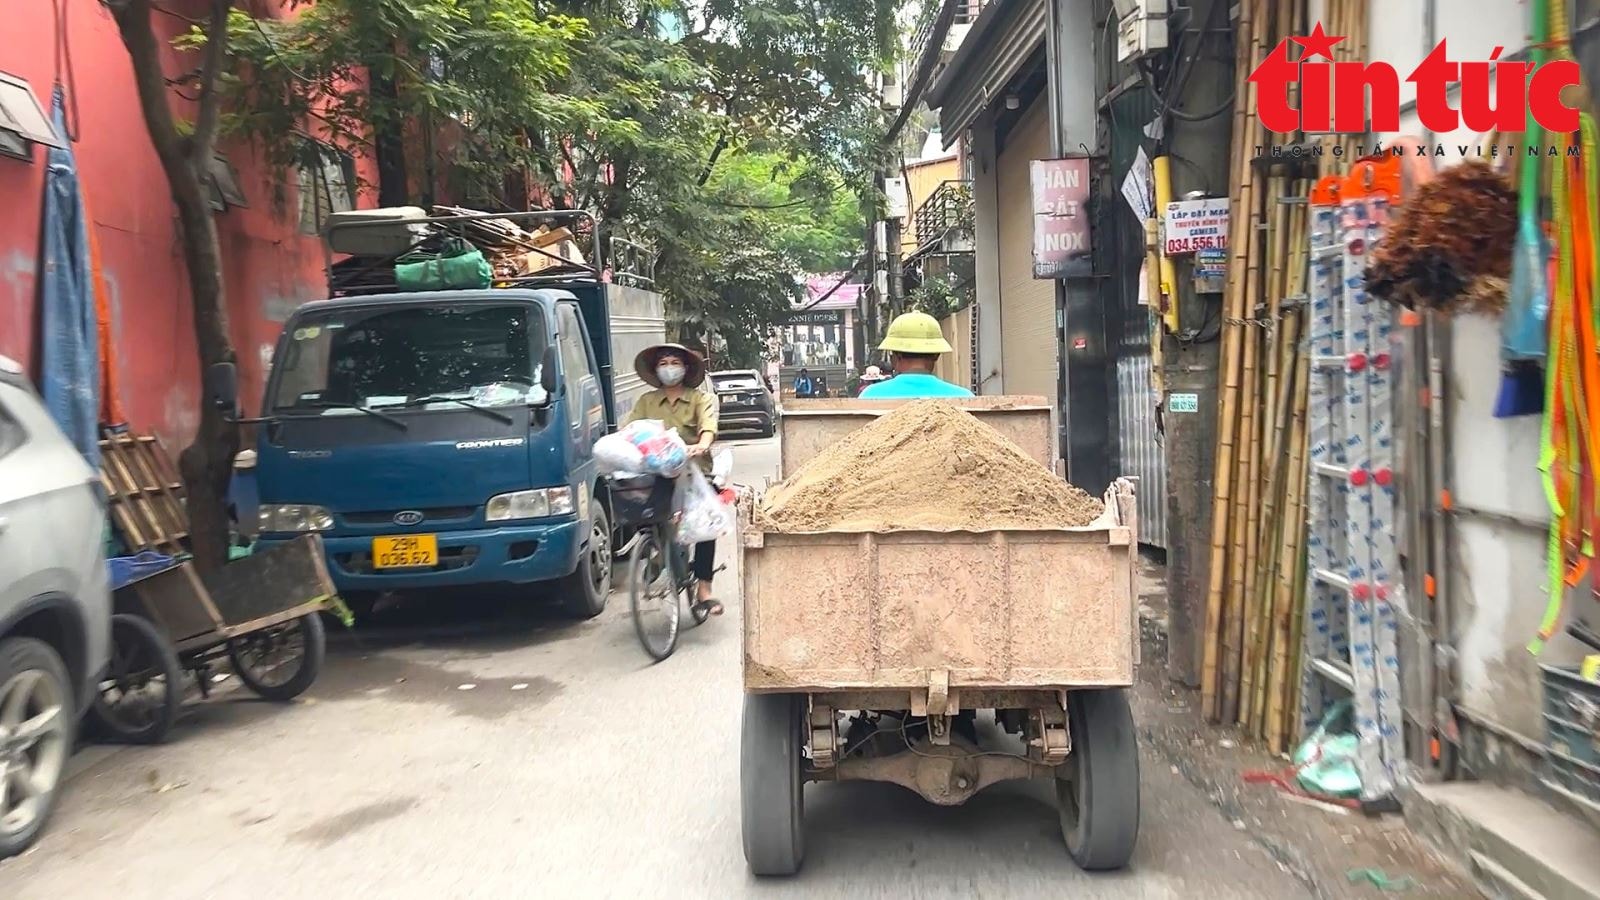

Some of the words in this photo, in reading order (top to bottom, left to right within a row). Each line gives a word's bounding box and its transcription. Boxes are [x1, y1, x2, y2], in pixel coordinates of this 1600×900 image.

[1042, 167, 1080, 189] HÀN
[1041, 232, 1085, 252] INOX
[1167, 235, 1230, 253] 034.556.11
[390, 537, 420, 552] 29H
